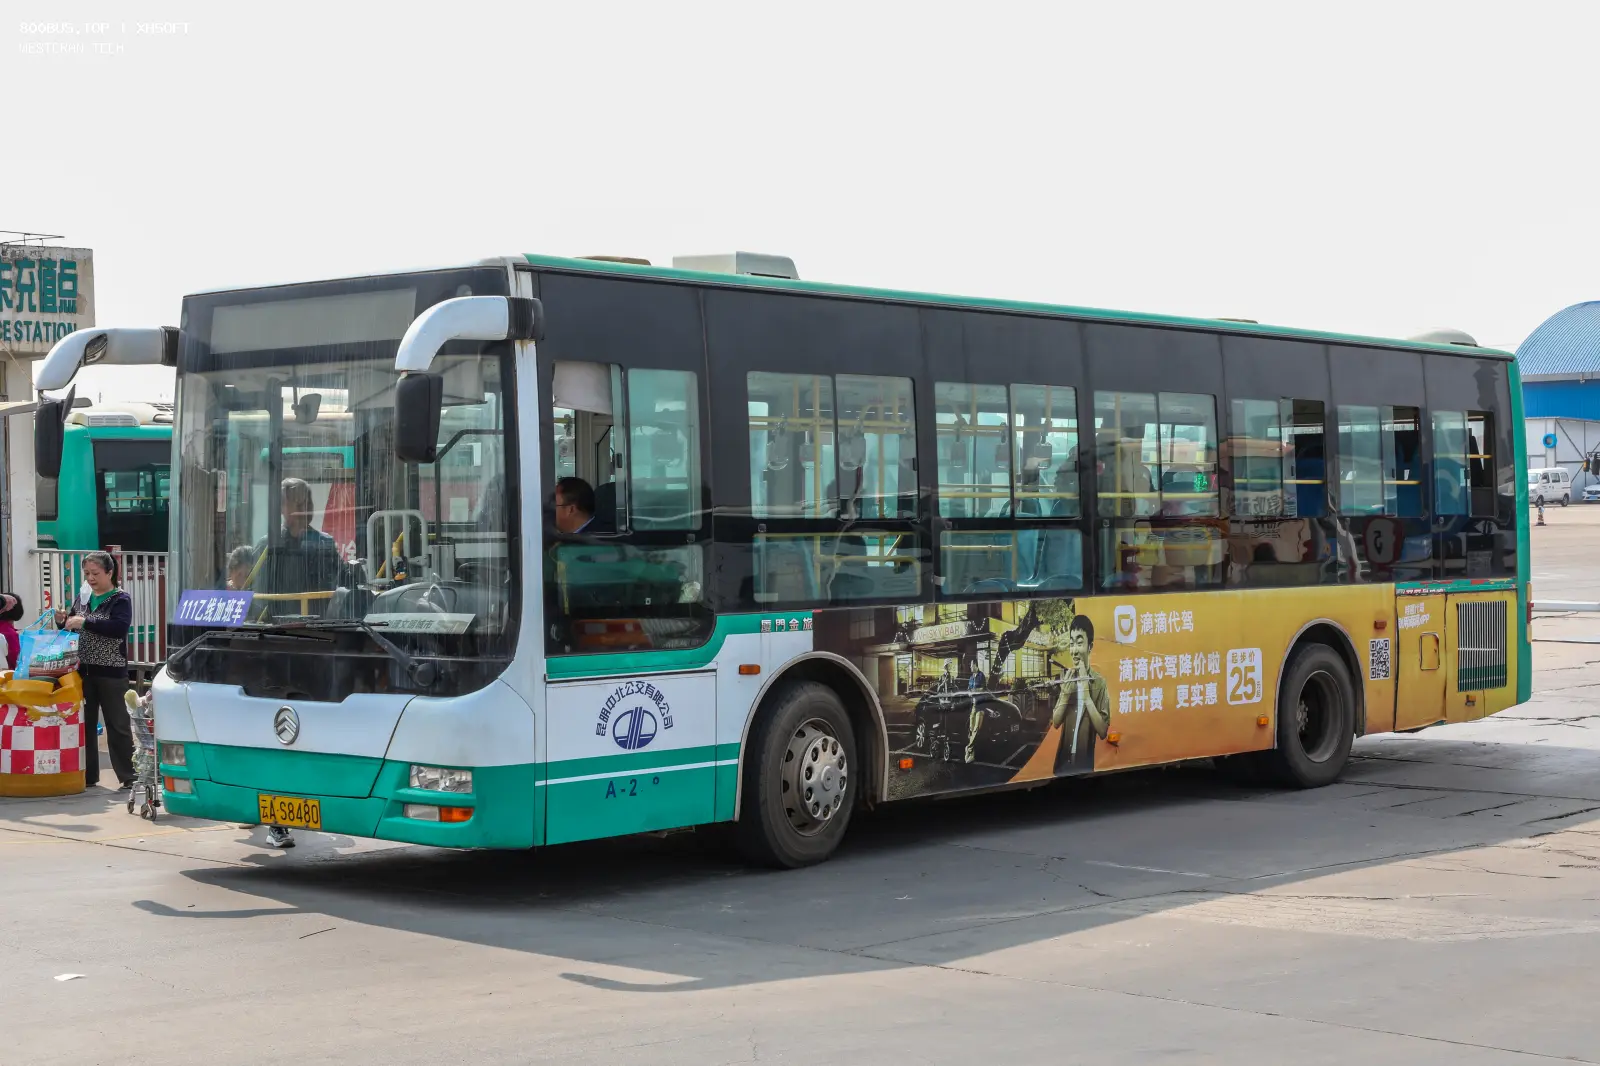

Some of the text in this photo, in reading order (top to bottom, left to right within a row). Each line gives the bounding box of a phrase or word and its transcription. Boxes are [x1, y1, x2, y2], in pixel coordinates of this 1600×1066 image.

[1140, 610, 1194, 635] 滴滴代驾
[1119, 651, 1221, 682] 滴滴代驾降价啦
[1231, 651, 1256, 664] 起步价
[1119, 682, 1218, 714] 新计费 更实惠
[1229, 665, 1256, 702] 25
[595, 680, 674, 737] 昆明中北公交有限公司
